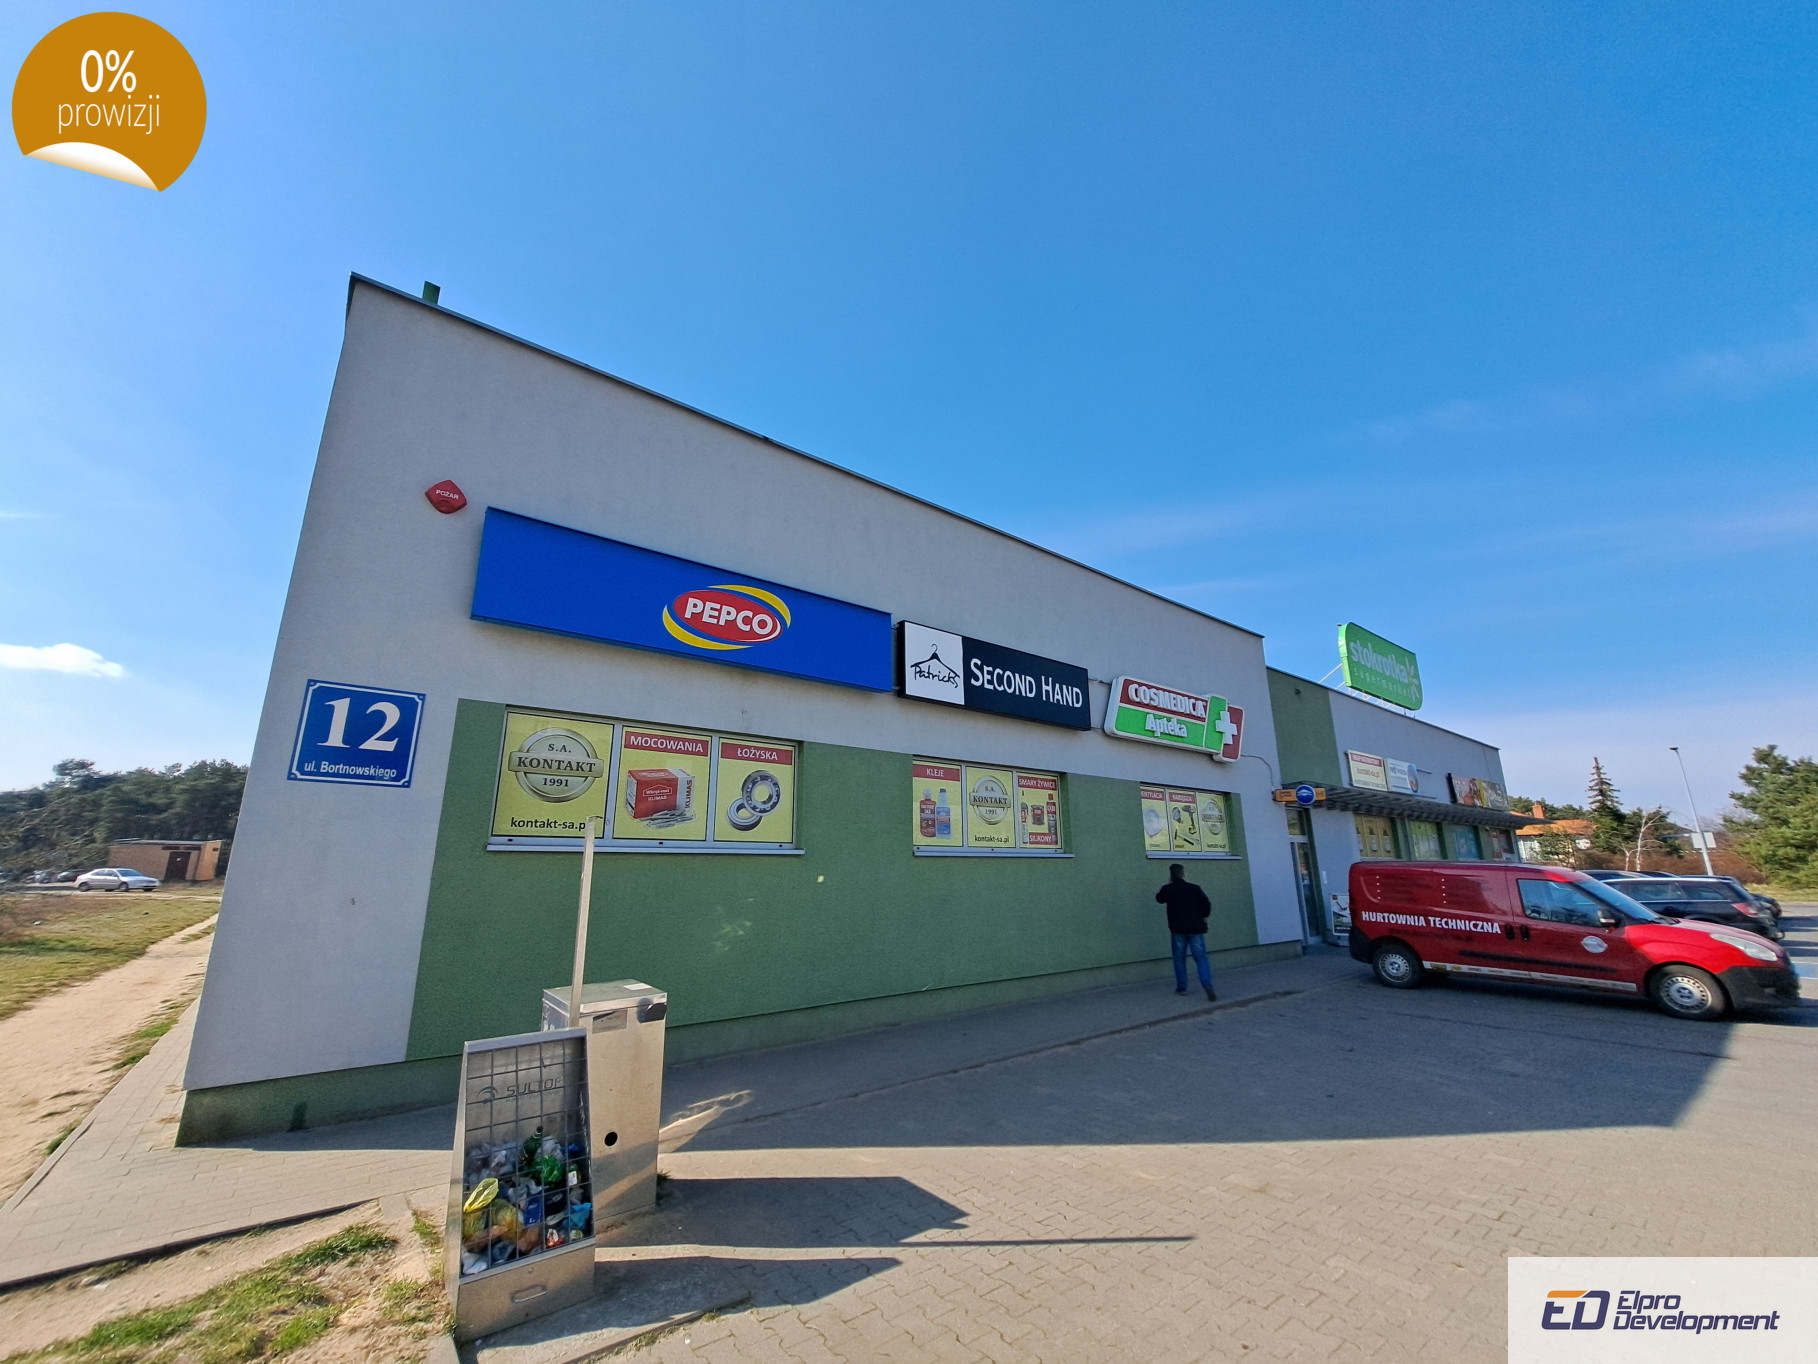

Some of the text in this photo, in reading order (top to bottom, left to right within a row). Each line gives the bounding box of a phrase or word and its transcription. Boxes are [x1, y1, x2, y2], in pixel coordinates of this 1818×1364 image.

[684, 597, 773, 635] PEPCO
[970, 658, 1083, 709] SECOND HAND
[1128, 683, 1207, 717] COSMEDICA
[316, 697, 401, 752] 12
[1145, 713, 1188, 738] Apteka
[547, 743, 572, 753] S.A.
[630, 735, 704, 753] MOCOWANIA
[737, 747, 778, 760] ŁOŻYSKA
[304, 761, 397, 780] ul. Bortnowskiego
[516, 756, 596, 772] KONTAKT
[926, 768, 945, 778] KLEJE
[542, 777, 570, 788] 1991
[684, 779, 693, 809] KLIMAS
[972, 795, 1009, 806] KONTAKT
[984, 808, 998, 816] 1991
[510, 817, 586, 832] kontakt-sa.p
[974, 834, 1010, 844] kontakt-sa.pl
[1362, 911, 1502, 934] HURTOWNIA TECHNICZNA
